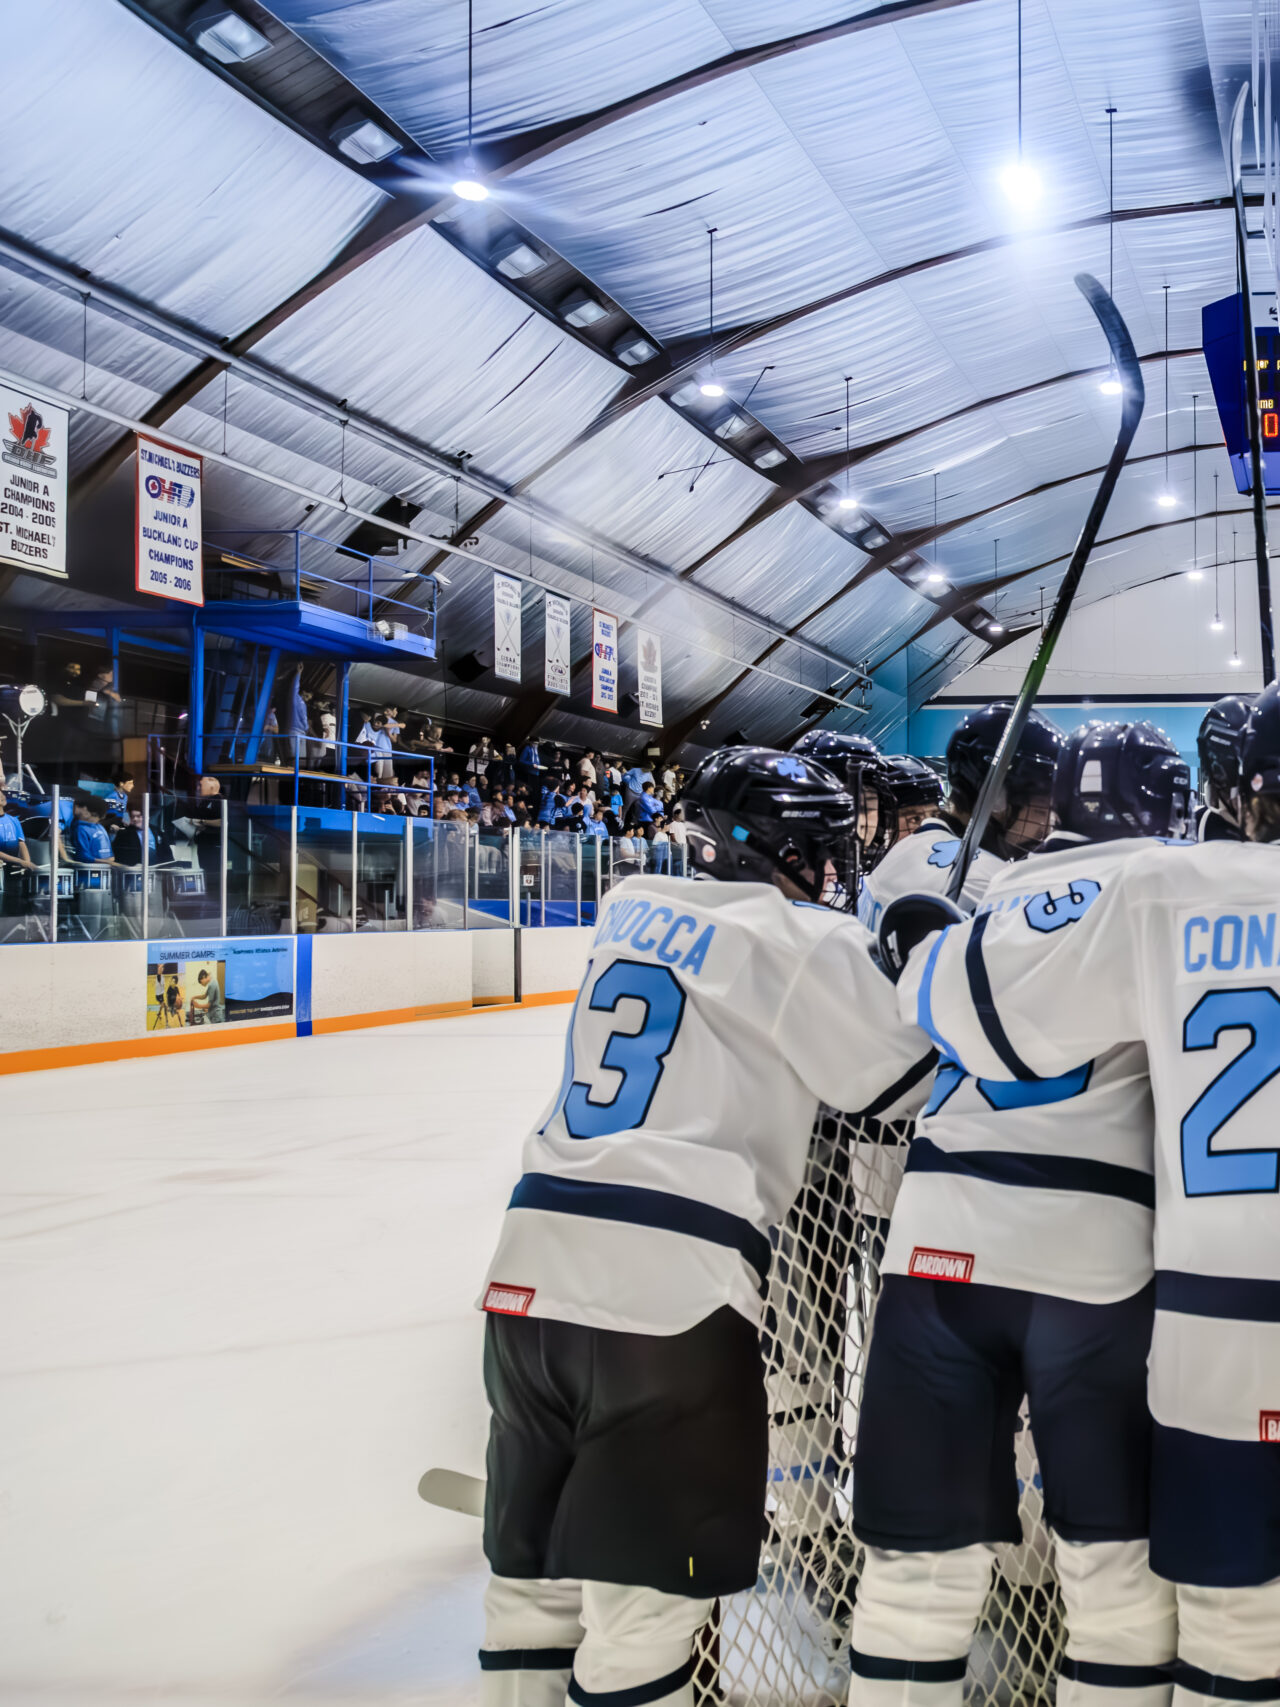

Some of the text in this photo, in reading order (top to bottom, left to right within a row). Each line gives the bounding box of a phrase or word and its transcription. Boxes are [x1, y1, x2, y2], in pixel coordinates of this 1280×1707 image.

[1264, 412, 1279, 437] 0
[10, 474, 50, 497] JUNIOR A
[3, 487, 56, 513] CHAMPIONS
[0, 502, 24, 519] 2004
[31, 512, 56, 528] 2005
[153, 510, 189, 529] JUNIOR A
[10, 539, 48, 559] BUZZERS
[142, 526, 199, 552] BUCKLAND CUP
[148, 548, 194, 572] CHAMPIONS
[150, 570, 168, 585] 2005
[174, 576, 192, 591] 2006
[160, 950, 216, 961] SUMMER CAMPS
[913, 1254, 967, 1280] BARDOWN
